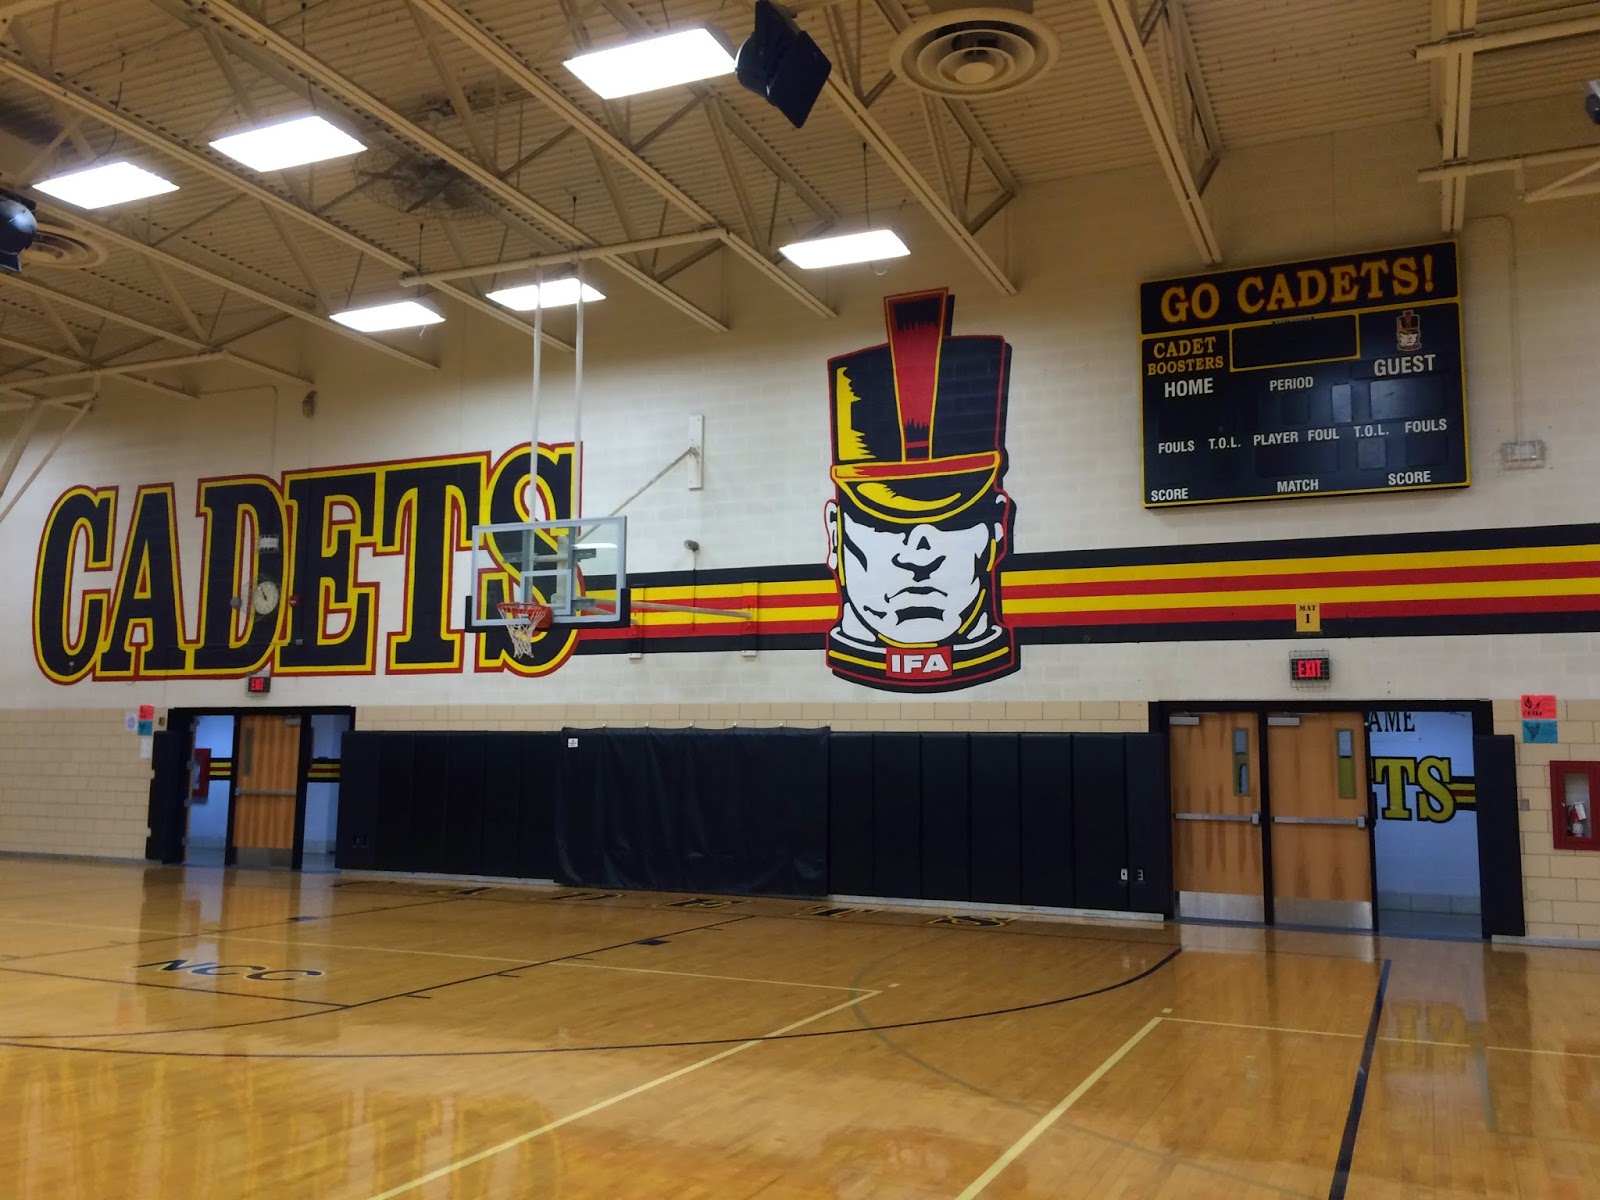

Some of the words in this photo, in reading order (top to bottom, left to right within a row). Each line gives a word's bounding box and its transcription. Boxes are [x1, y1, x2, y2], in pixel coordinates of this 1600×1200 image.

[1160, 282, 1220, 324] GO
[1237, 254, 1434, 314] CADETS!
[1152, 336, 1217, 359] CADET
[1147, 355, 1225, 376] BOOSTERS
[1373, 354, 1437, 377] GUEST
[1163, 377, 1214, 398] HOME
[1269, 376, 1314, 391] PERIOD
[1353, 425, 1390, 438] T.O.L.
[1404, 418, 1448, 434] FOULS
[1208, 438, 1241, 450] T.O.L.
[1253, 431, 1299, 447] PLAYER
[1307, 428, 1340, 442] FOUL
[1158, 440, 1195, 455] FOULS
[1276, 479, 1319, 494] MATCH
[1388, 470, 1431, 487] SCORE
[1151, 488, 1189, 503] SCORE
[33, 442, 582, 685] CADETS
[1299, 604, 1316, 612] MAT
[891, 653, 949, 674] IFA
[1297, 660, 1323, 678] EXIT
[131, 959, 324, 981] NCC
